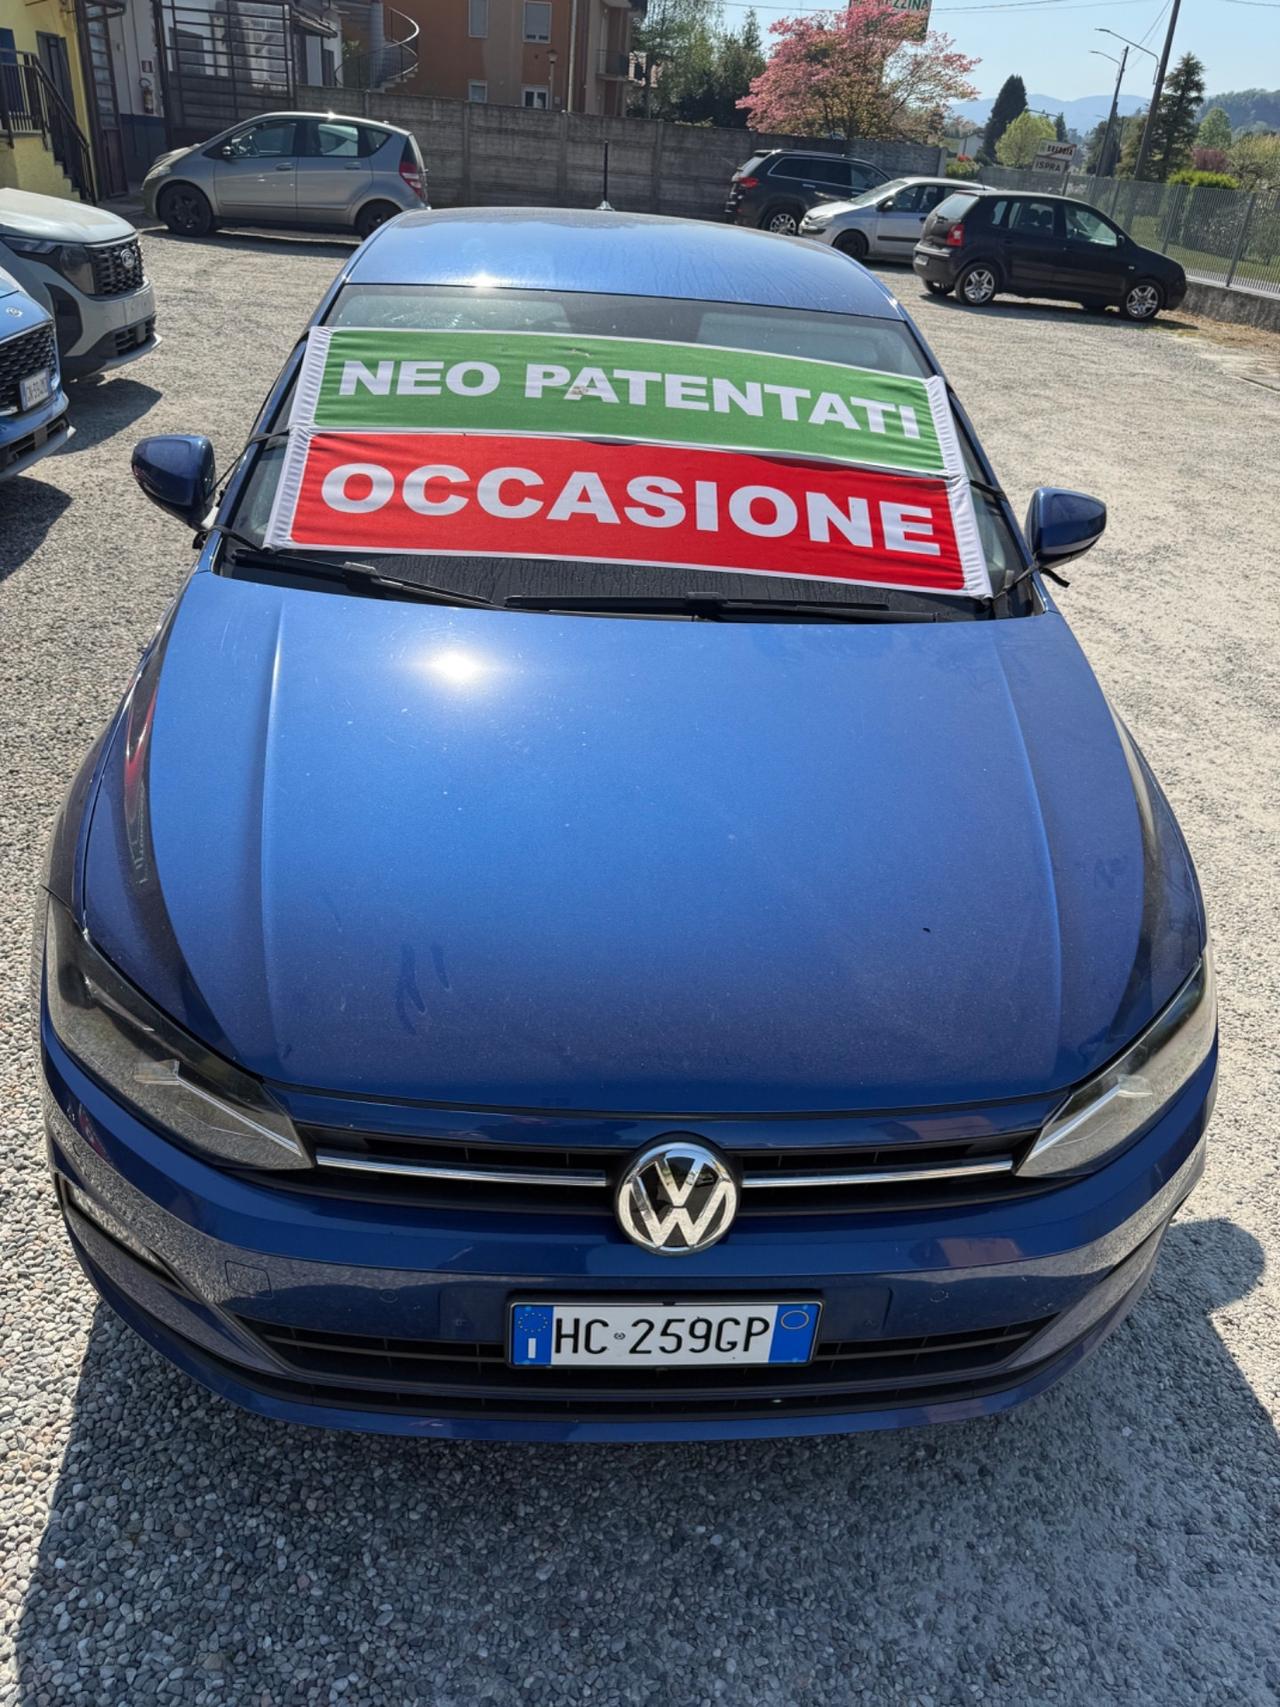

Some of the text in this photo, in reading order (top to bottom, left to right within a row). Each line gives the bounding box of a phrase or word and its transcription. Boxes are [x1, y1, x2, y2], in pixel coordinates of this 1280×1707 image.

[339, 361, 920, 440] NEO PATENTATI
[321, 463, 941, 556] OCCASIONE
